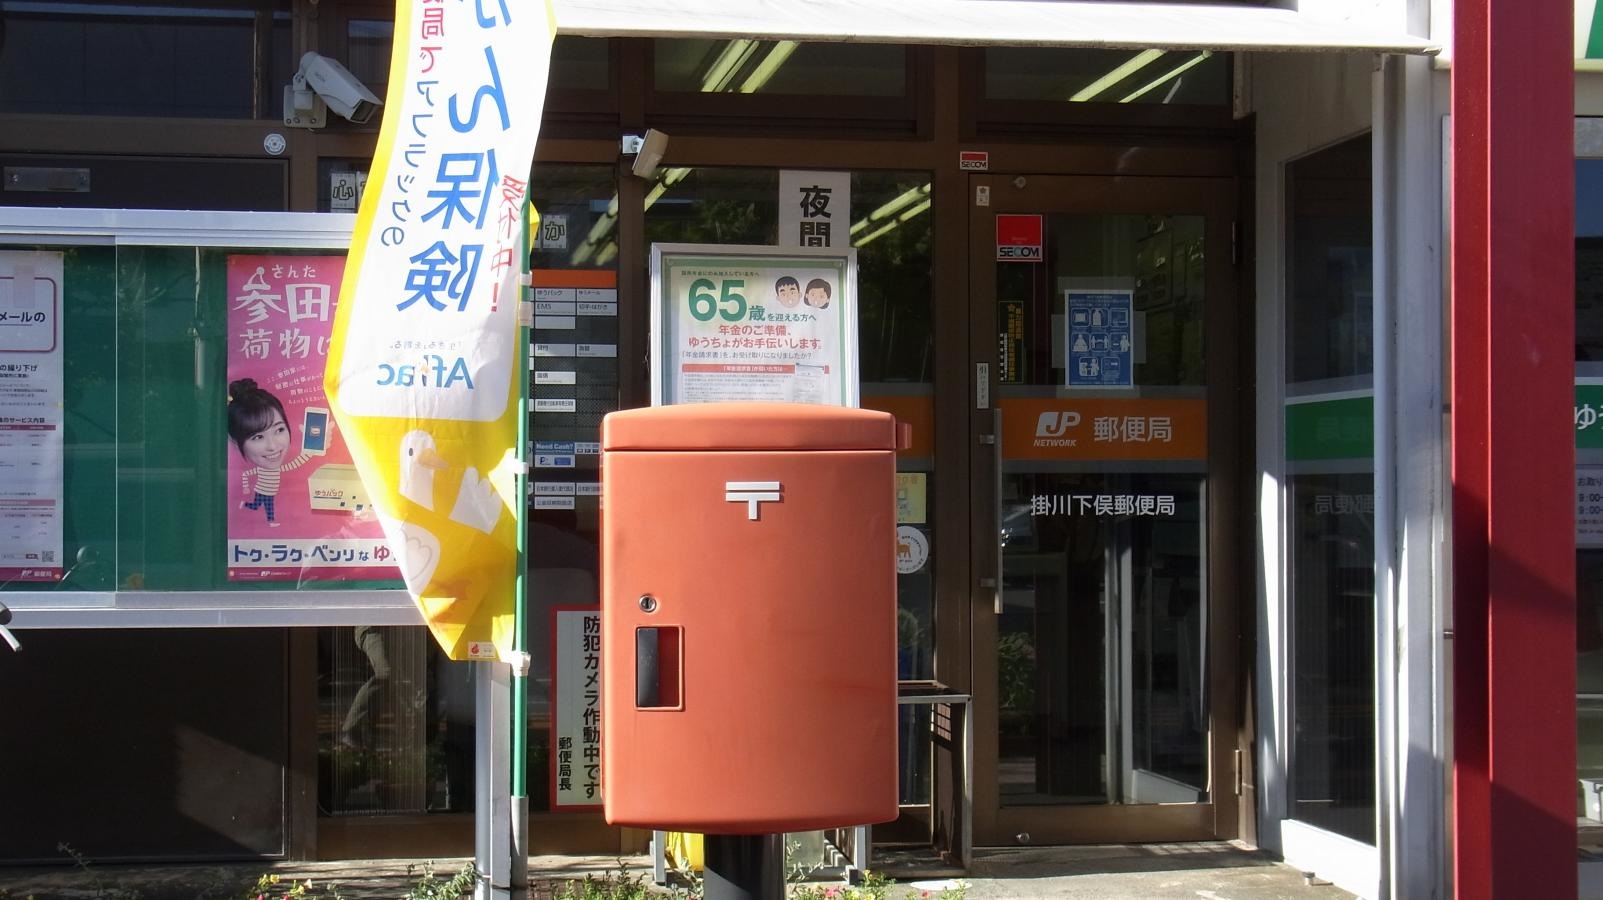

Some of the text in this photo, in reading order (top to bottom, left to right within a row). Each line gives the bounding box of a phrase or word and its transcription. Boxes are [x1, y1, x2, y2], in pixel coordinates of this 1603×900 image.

[332, 179, 354, 201] 心
[544, 220, 566, 242] か
[999, 246, 1040, 257] SECOM
[271, 264, 316, 279] さんた
[232, 266, 339, 324] 参田
[536, 303, 552, 311] EMS
[718, 324, 792, 337] 年金のご準備、
[688, 337, 822, 350] ゆうちょがお手伝いします。
[1574, 403, 1603, 430] ゆ
[1093, 416, 1173, 443] 郵便局
[1033, 439, 1077, 447] NETWORK
[314, 489, 344, 497] ゆうパック
[1030, 494, 1176, 516] 掛川下俣郵便局
[582, 615, 601, 799] 防犯カメラ作動中です
[558, 736, 572, 792] 郵便局長
